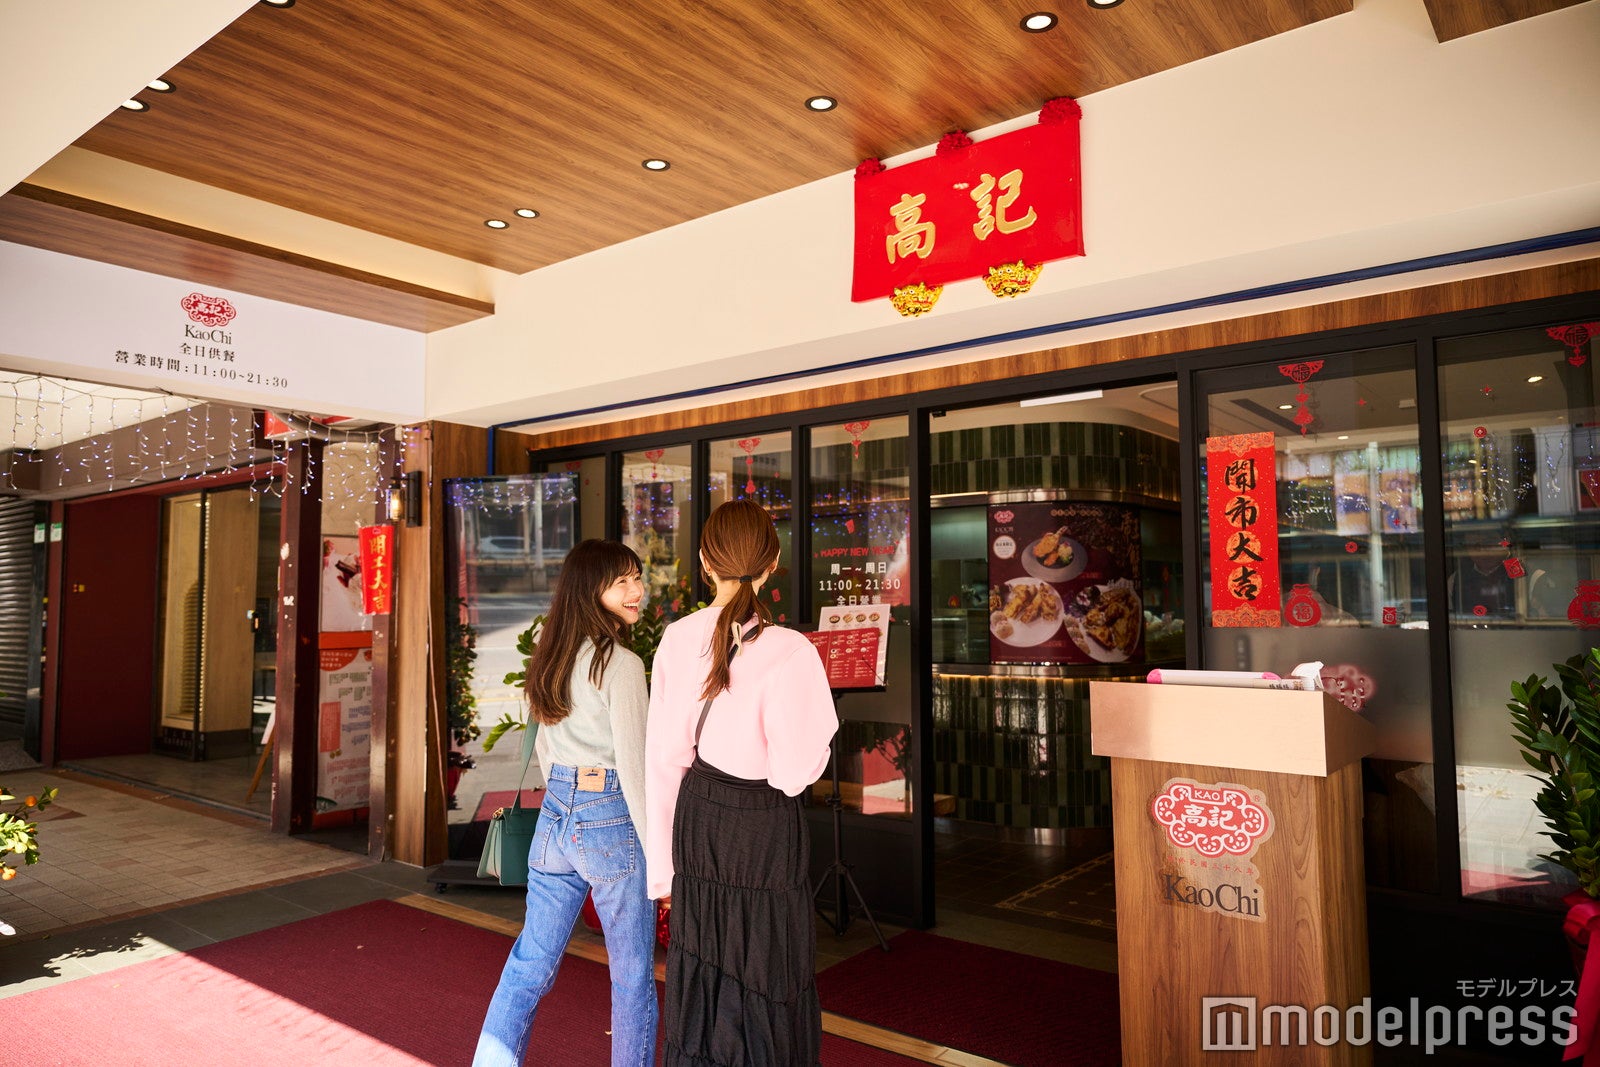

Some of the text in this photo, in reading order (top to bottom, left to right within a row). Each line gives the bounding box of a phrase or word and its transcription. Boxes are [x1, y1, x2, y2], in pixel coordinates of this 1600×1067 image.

[886, 168, 1037, 264] 高記
[185, 324, 232, 345] KaoChi
[180, 342, 235, 363] 全日供餐
[1224, 458, 1264, 601] 開市大吉
[821, 548, 848, 557] HAPPY
[850, 547, 869, 557] NEW
[368, 534, 388, 610] 開工大吉
[1194, 790, 1220, 801] KAO
[1181, 804, 1238, 831] 高記
[1163, 873, 1261, 917] KaoChi
